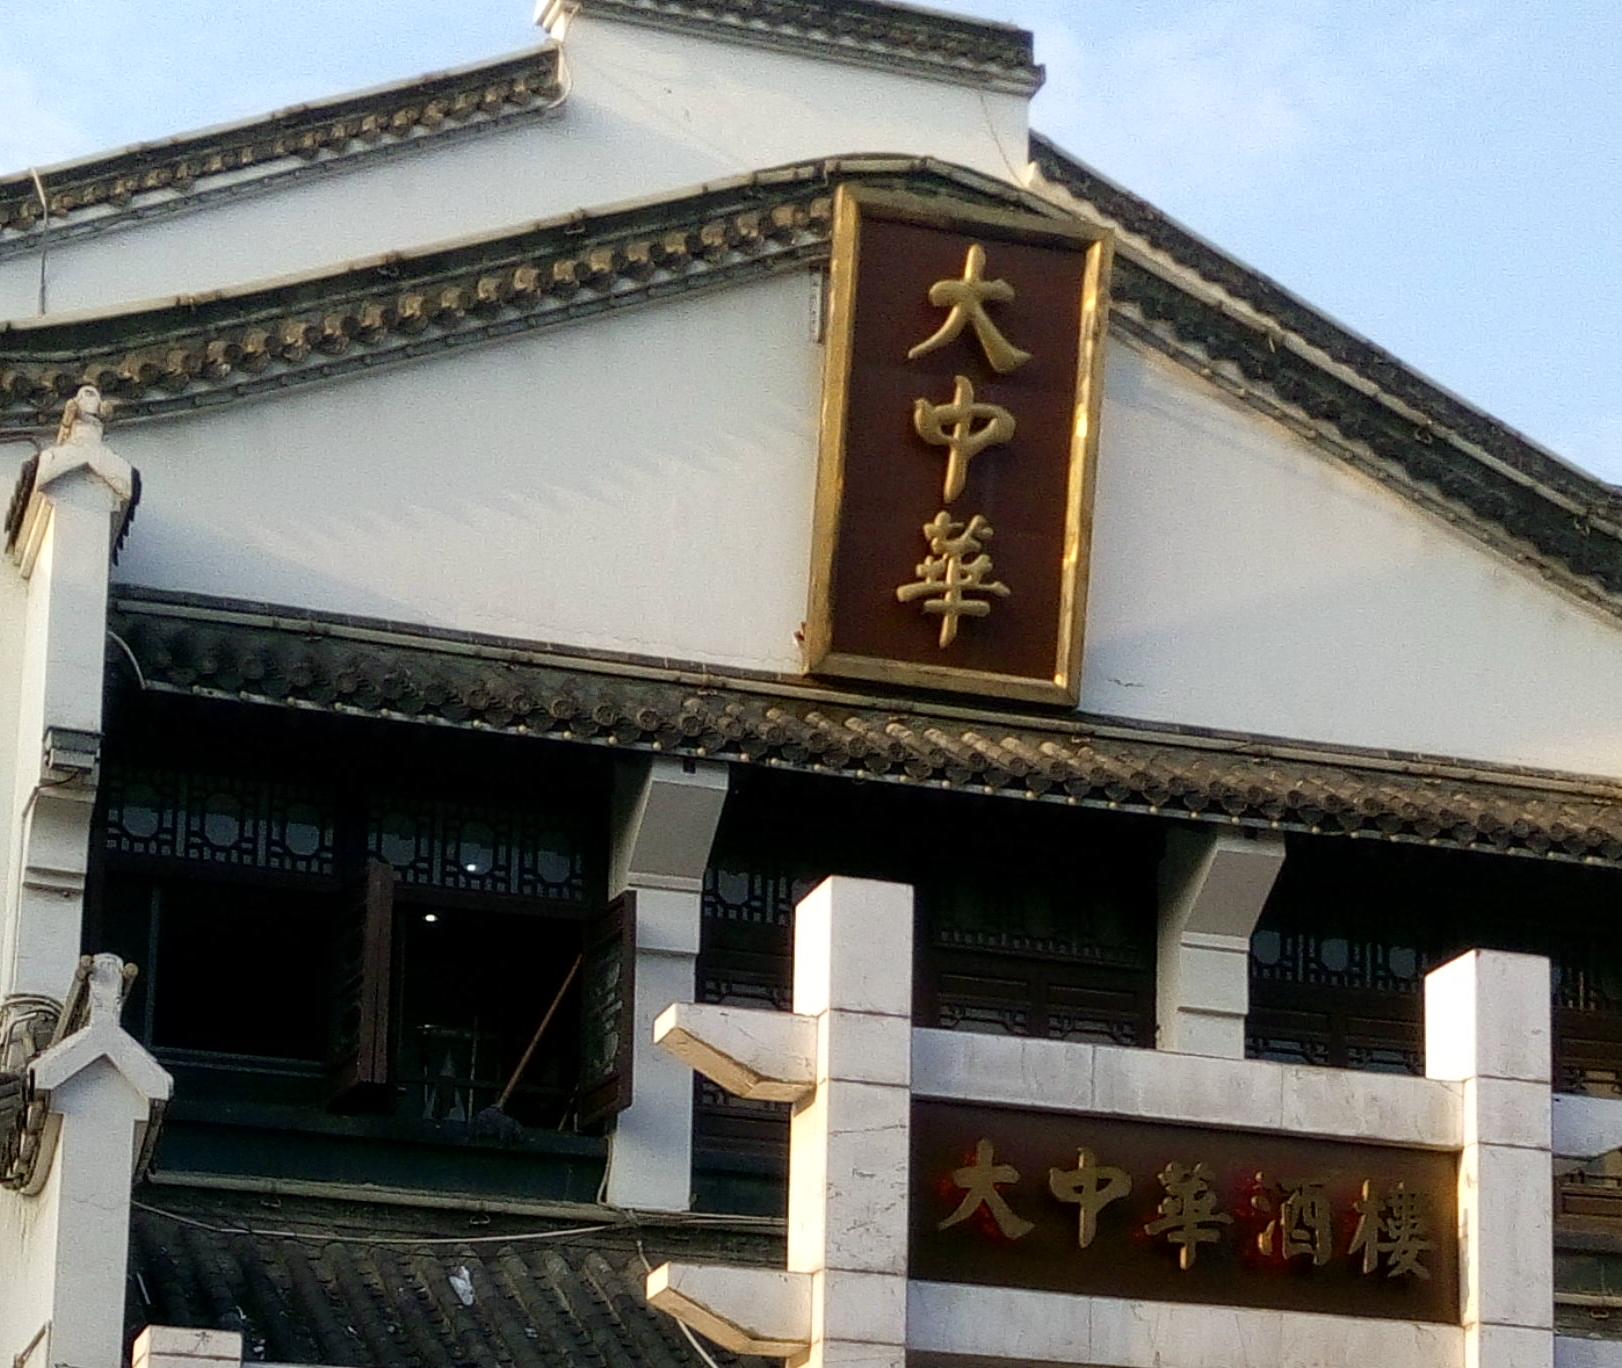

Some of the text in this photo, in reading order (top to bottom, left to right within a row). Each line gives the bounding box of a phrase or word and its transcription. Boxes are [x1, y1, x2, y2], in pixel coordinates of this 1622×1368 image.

[896, 243, 1032, 648] 大中華
[938, 1138, 1432, 1280] 大中華酒樓
